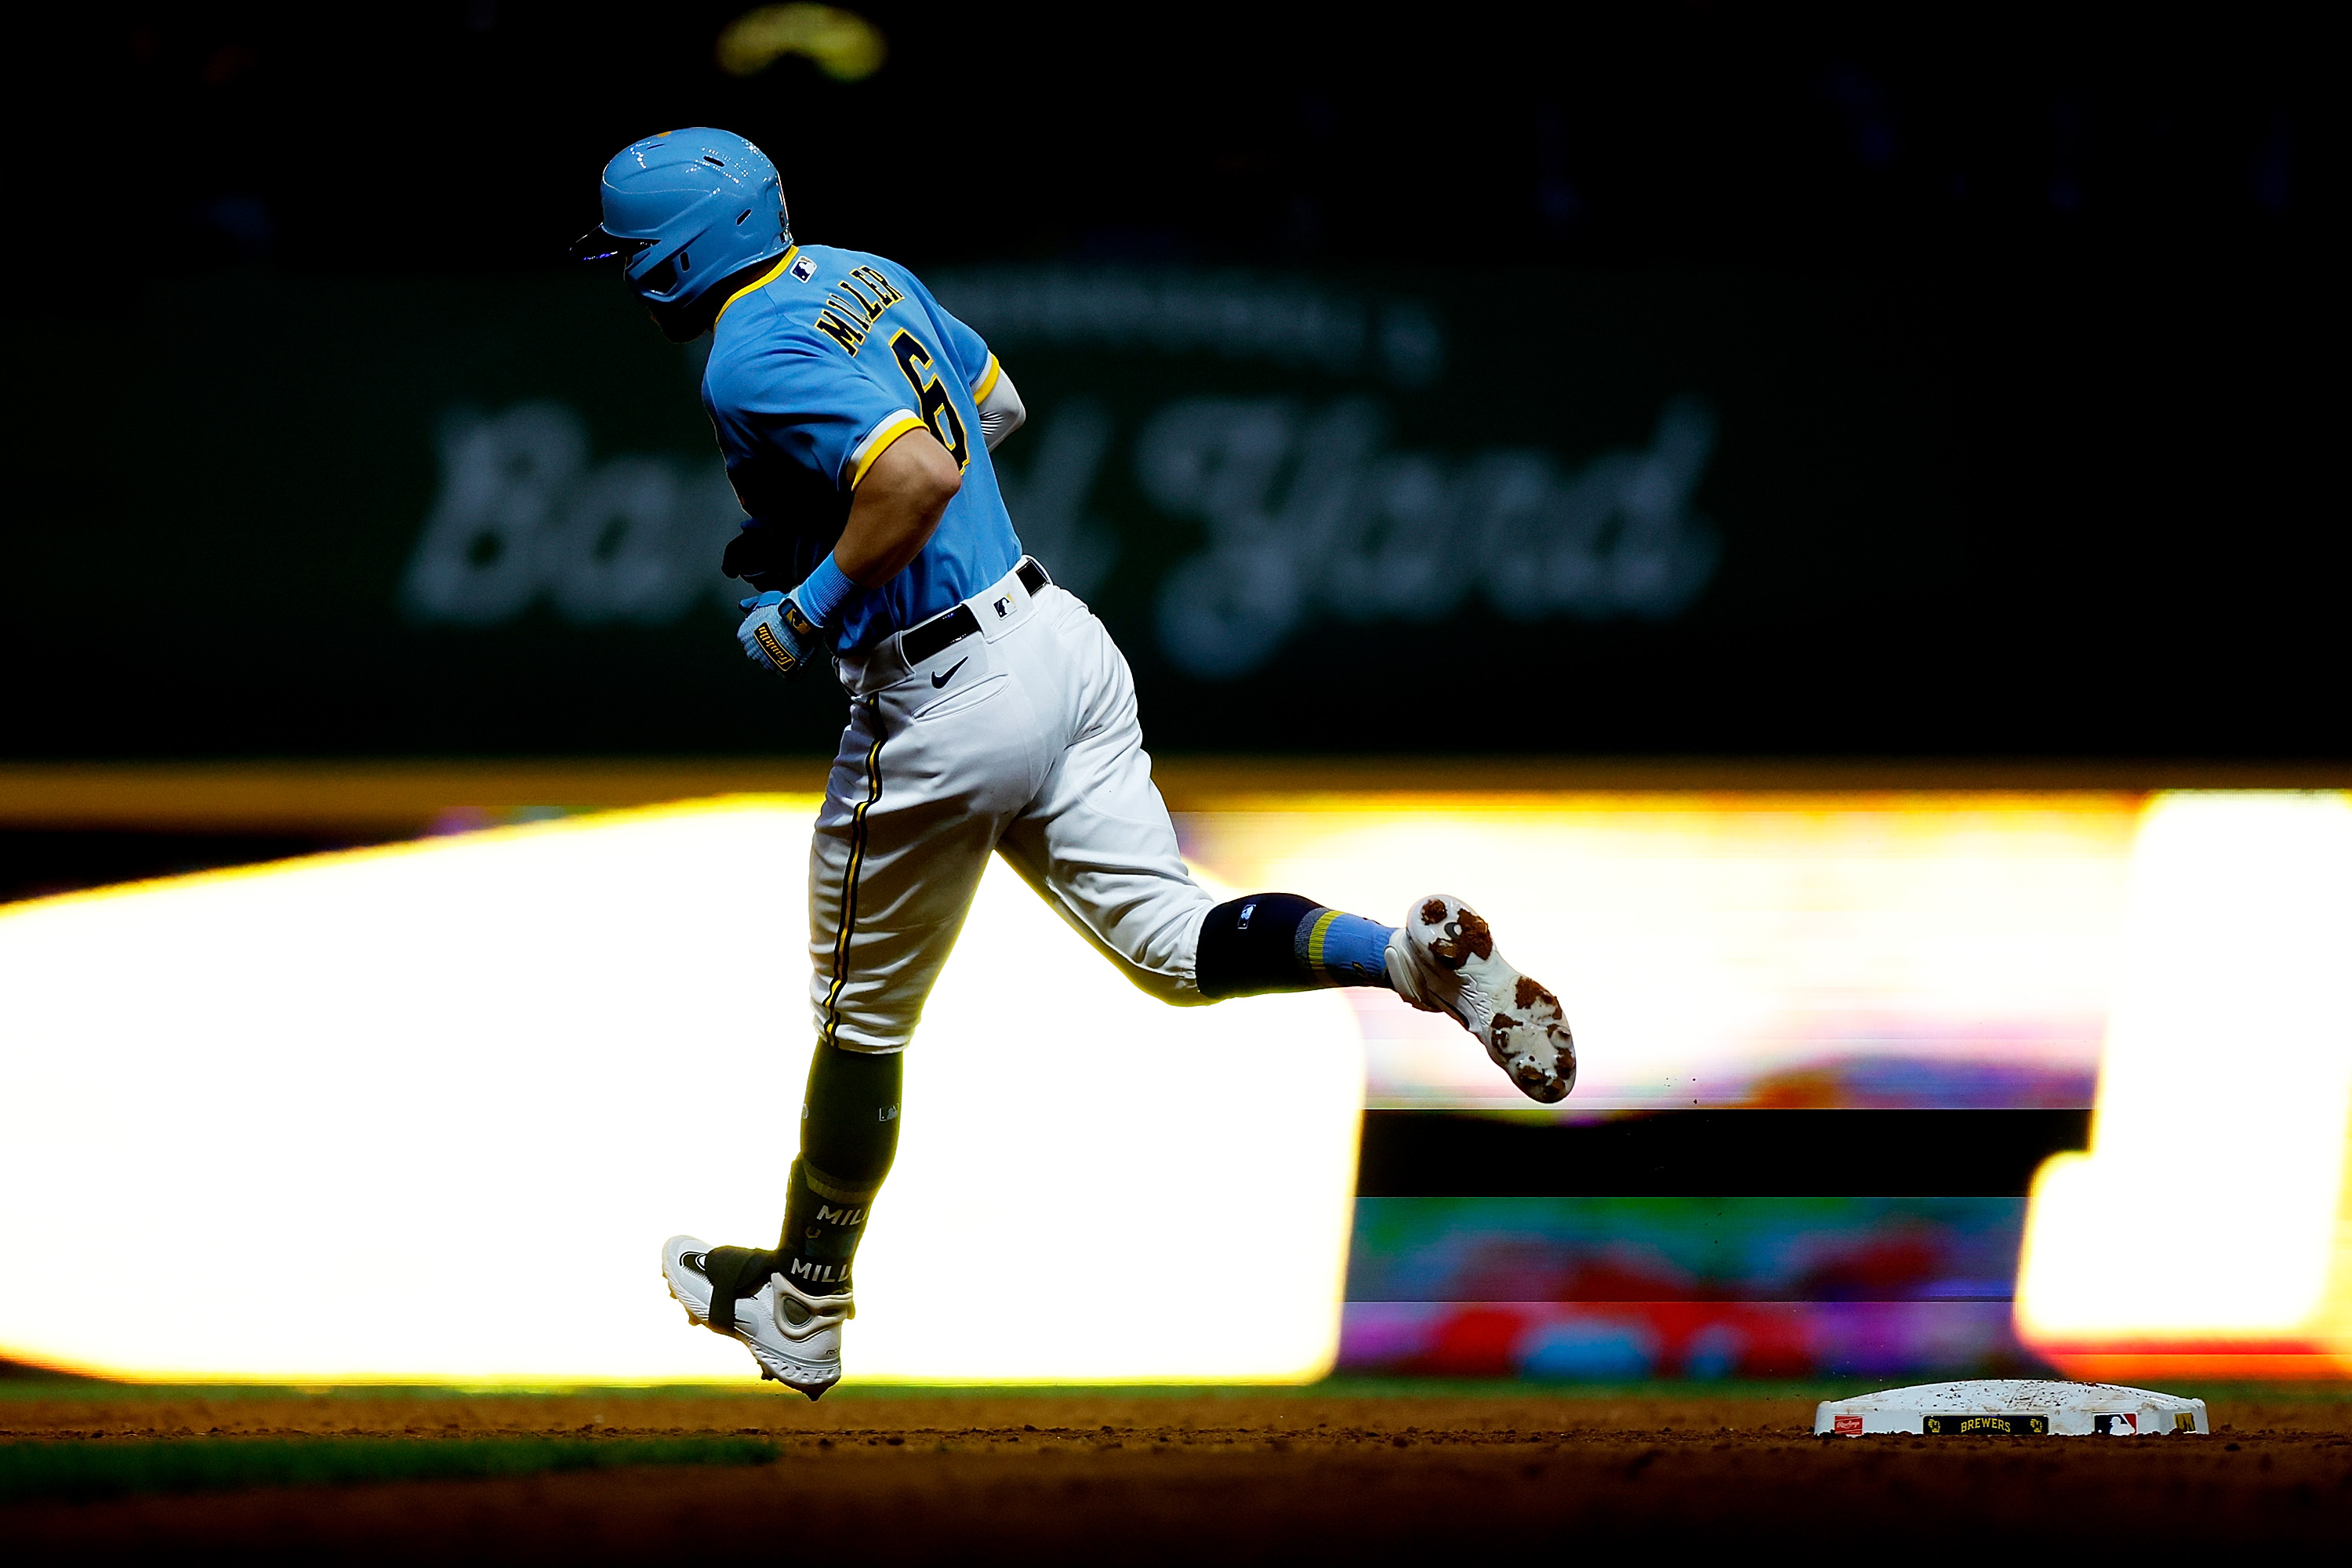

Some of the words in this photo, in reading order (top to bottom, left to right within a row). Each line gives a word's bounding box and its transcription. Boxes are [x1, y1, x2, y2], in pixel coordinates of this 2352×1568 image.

[888, 327, 970, 476] 6
[398, 396, 1118, 627] Bal
[816, 1204, 870, 1225] MIL
[1961, 1417, 2011, 1433] BREWERS
